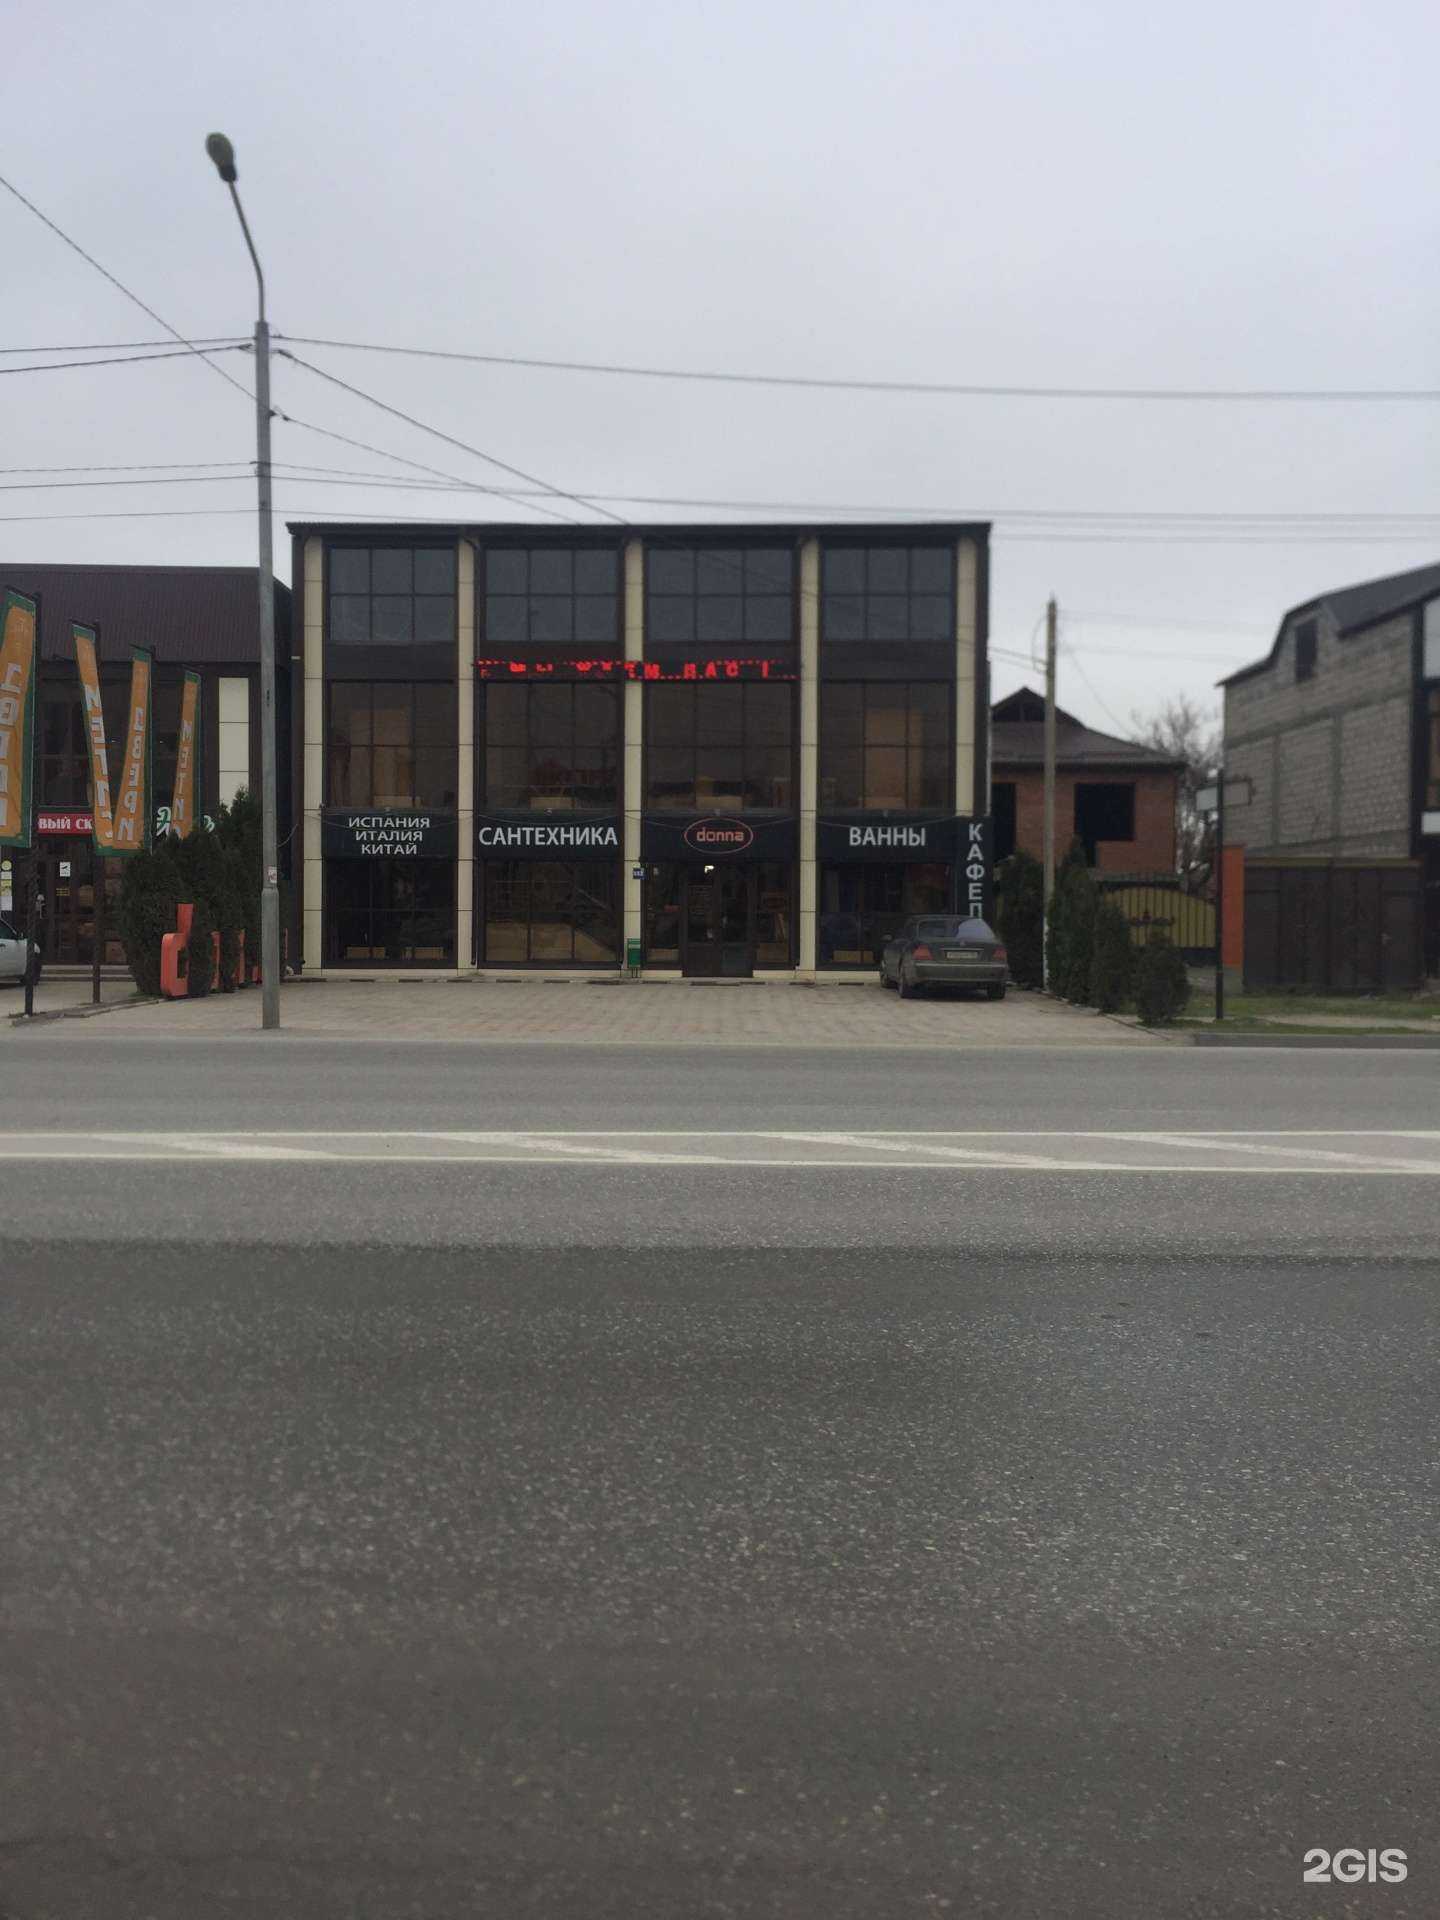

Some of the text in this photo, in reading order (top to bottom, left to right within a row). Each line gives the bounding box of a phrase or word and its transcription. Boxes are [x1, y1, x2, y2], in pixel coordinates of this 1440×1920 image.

[38, 815, 93, 830] ВЫЙ СК
[348, 816, 430, 828] ИСПАНИЯ
[355, 830, 423, 841] ИТАЛИЯ
[478, 827, 618, 846] САНТЕХНИКА
[696, 827, 744, 842] donna
[849, 826, 926, 847] ВАННЫ
[361, 842, 417, 855] КИТАЙ
